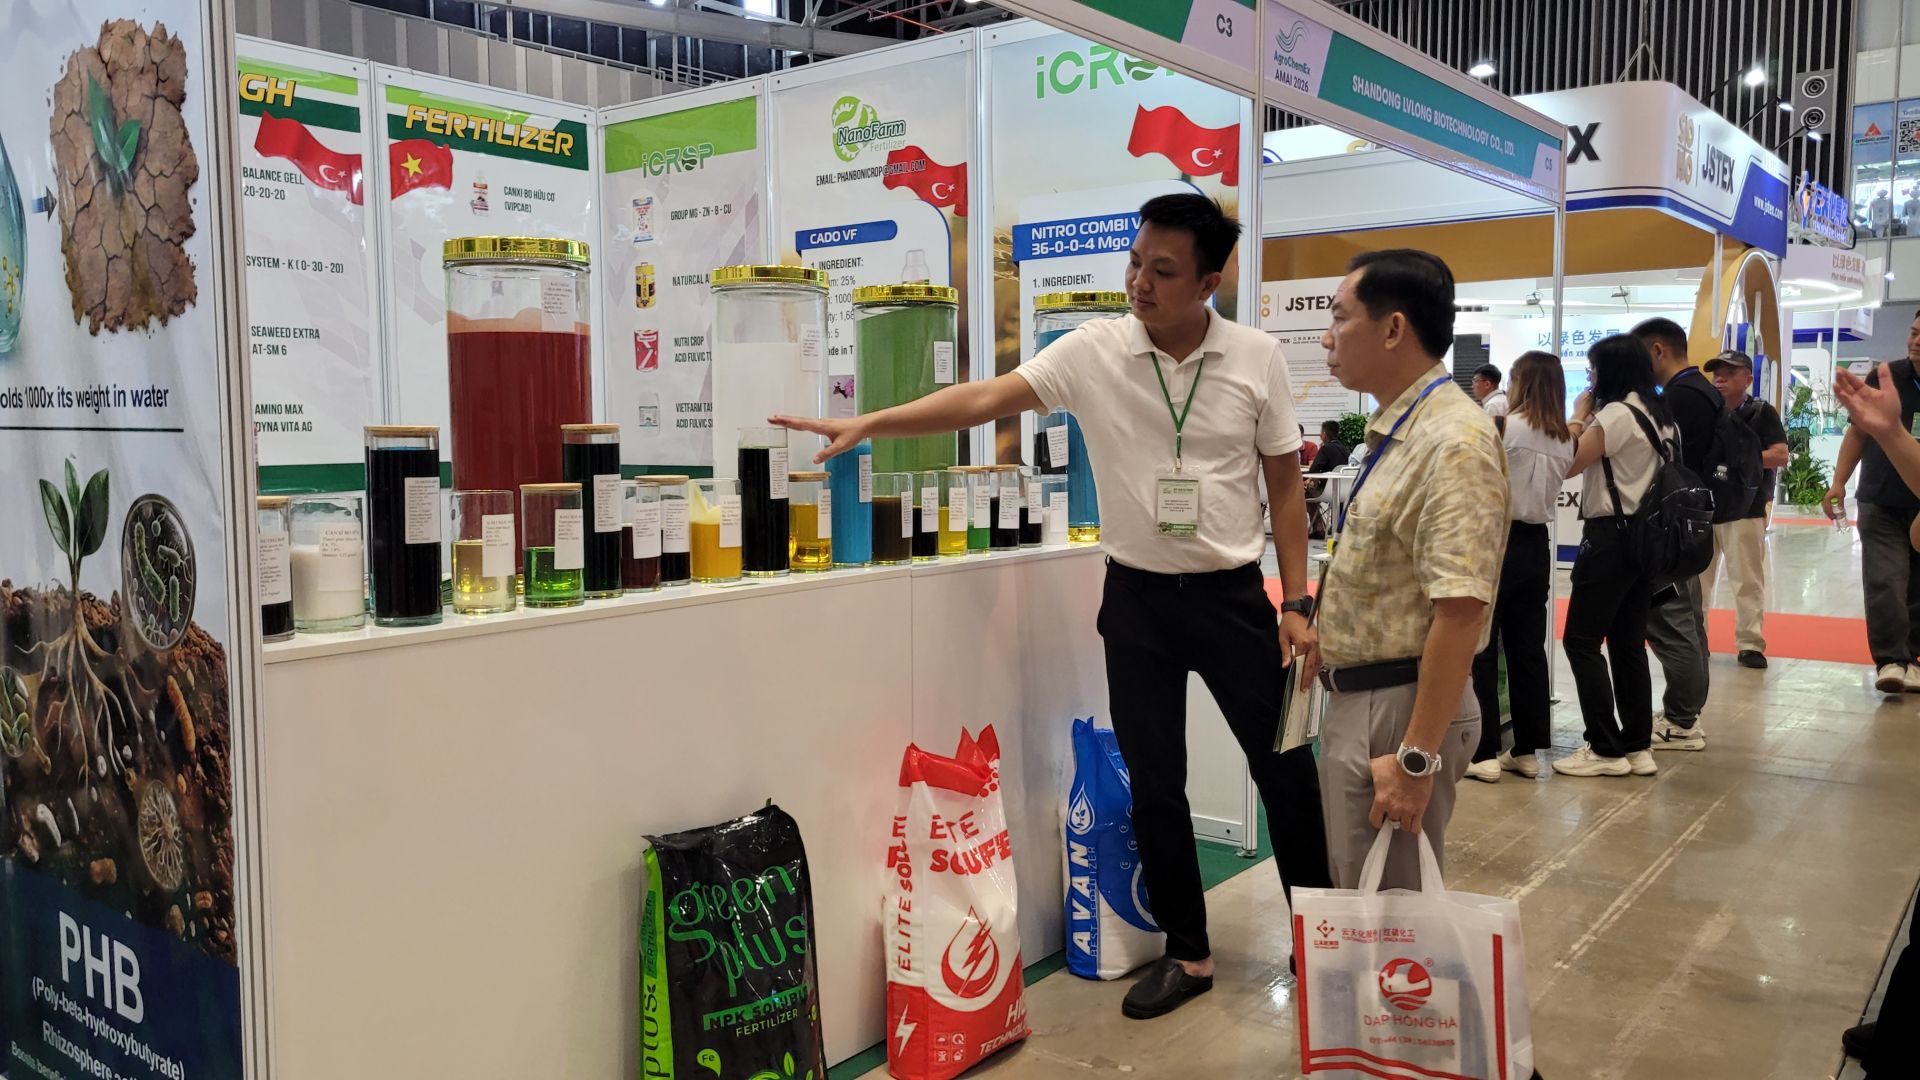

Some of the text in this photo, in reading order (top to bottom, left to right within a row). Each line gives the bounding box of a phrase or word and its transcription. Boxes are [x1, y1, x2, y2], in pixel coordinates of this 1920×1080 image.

[1216, 13, 1233, 38] C3
[1273, 50, 1311, 75] AgroChemEx
[239, 72, 297, 108] GH
[1274, 68, 1309, 93] AMAI 2026
[1352, 74, 1401, 110] SHANDONG
[1402, 96, 1433, 123] LVLONG
[1433, 110, 1490, 146] BIOTECHNOLOGY
[1504, 140, 1516, 157] LTD.
[405, 103, 574, 157] FERTILIZER
[837, 120, 906, 145] NanoFarm
[870, 138, 906, 153] Fertilizer
[243, 166, 305, 185] BALANCE GELL
[816, 159, 926, 186] EMAIL: PHANBONICROP@GMAIL.COM
[1702, 143, 1736, 195] JSTEX
[243, 185, 286, 201] 20-20-20
[503, 186, 523, 198] CANXI
[670, 208, 689, 221] GROUP
[689, 207, 698, 219] MG
[702, 206, 710, 217] ZN
[714, 206, 719, 216] B
[723, 203, 732, 215] CU
[1753, 195, 1784, 221] www.jstex.com
[809, 228, 858, 245] CADO VF
[1031, 217, 1142, 240] NITRO COMBI V
[1031, 236, 1130, 256] 36-0-0-4 Mgo
[246, 255, 280, 269] SYSTEM
[287, 259, 294, 270] K
[312, 261, 323, 272] 30
[330, 262, 344, 274] 20)
[818, 257, 864, 271] INGREDIENT:
[672, 274, 704, 287] NATURCAL
[840, 275, 856, 286] 25%
[1033, 273, 1095, 288] 1. INGREDIENT:
[1285, 294, 1337, 312] JSTEX
[251, 325, 320, 340] SEAWEED EXTRA
[674, 335, 704, 347] NUTRI CROP
[834, 328, 839, 338] 5
[1537, 328, 1620, 347] 以绿色发
[252, 343, 287, 356] AT-SM 6
[674, 352, 687, 363] ACID
[687, 351, 705, 362] FULVIC
[841, 345, 848, 356] in
[849, 345, 854, 355] T
[25, 385, 55, 409] 1000x
[57, 385, 73, 409] its
[75, 384, 111, 414] weight
[113, 384, 127, 408] in
[131, 386, 169, 409] water
[675, 402, 703, 413] VIETFARM
[254, 403, 304, 415] AMINO MAX
[280, 421, 300, 432] VITA
[301, 421, 313, 432] AG
[676, 419, 688, 429] ACID
[689, 418, 707, 429] FULVIC
[1069, 839, 1092, 956] AVAN
[668, 865, 797, 963] green
[897, 896, 912, 971] ELITE
[1090, 924, 1098, 957] BEST
[717, 915, 808, 998] plus
[59, 910, 144, 1024] PHB
[32, 976, 185, 1080] (Poly-beta-hydroxybutyrate)
[709, 1009, 745, 1029] NPK
[735, 1008, 799, 1038] FERTILIZER
[644, 992, 671, 1079] plus
[42, 1020, 113, 1079] Rhizosphere
[701, 1054, 716, 1063] Fe
